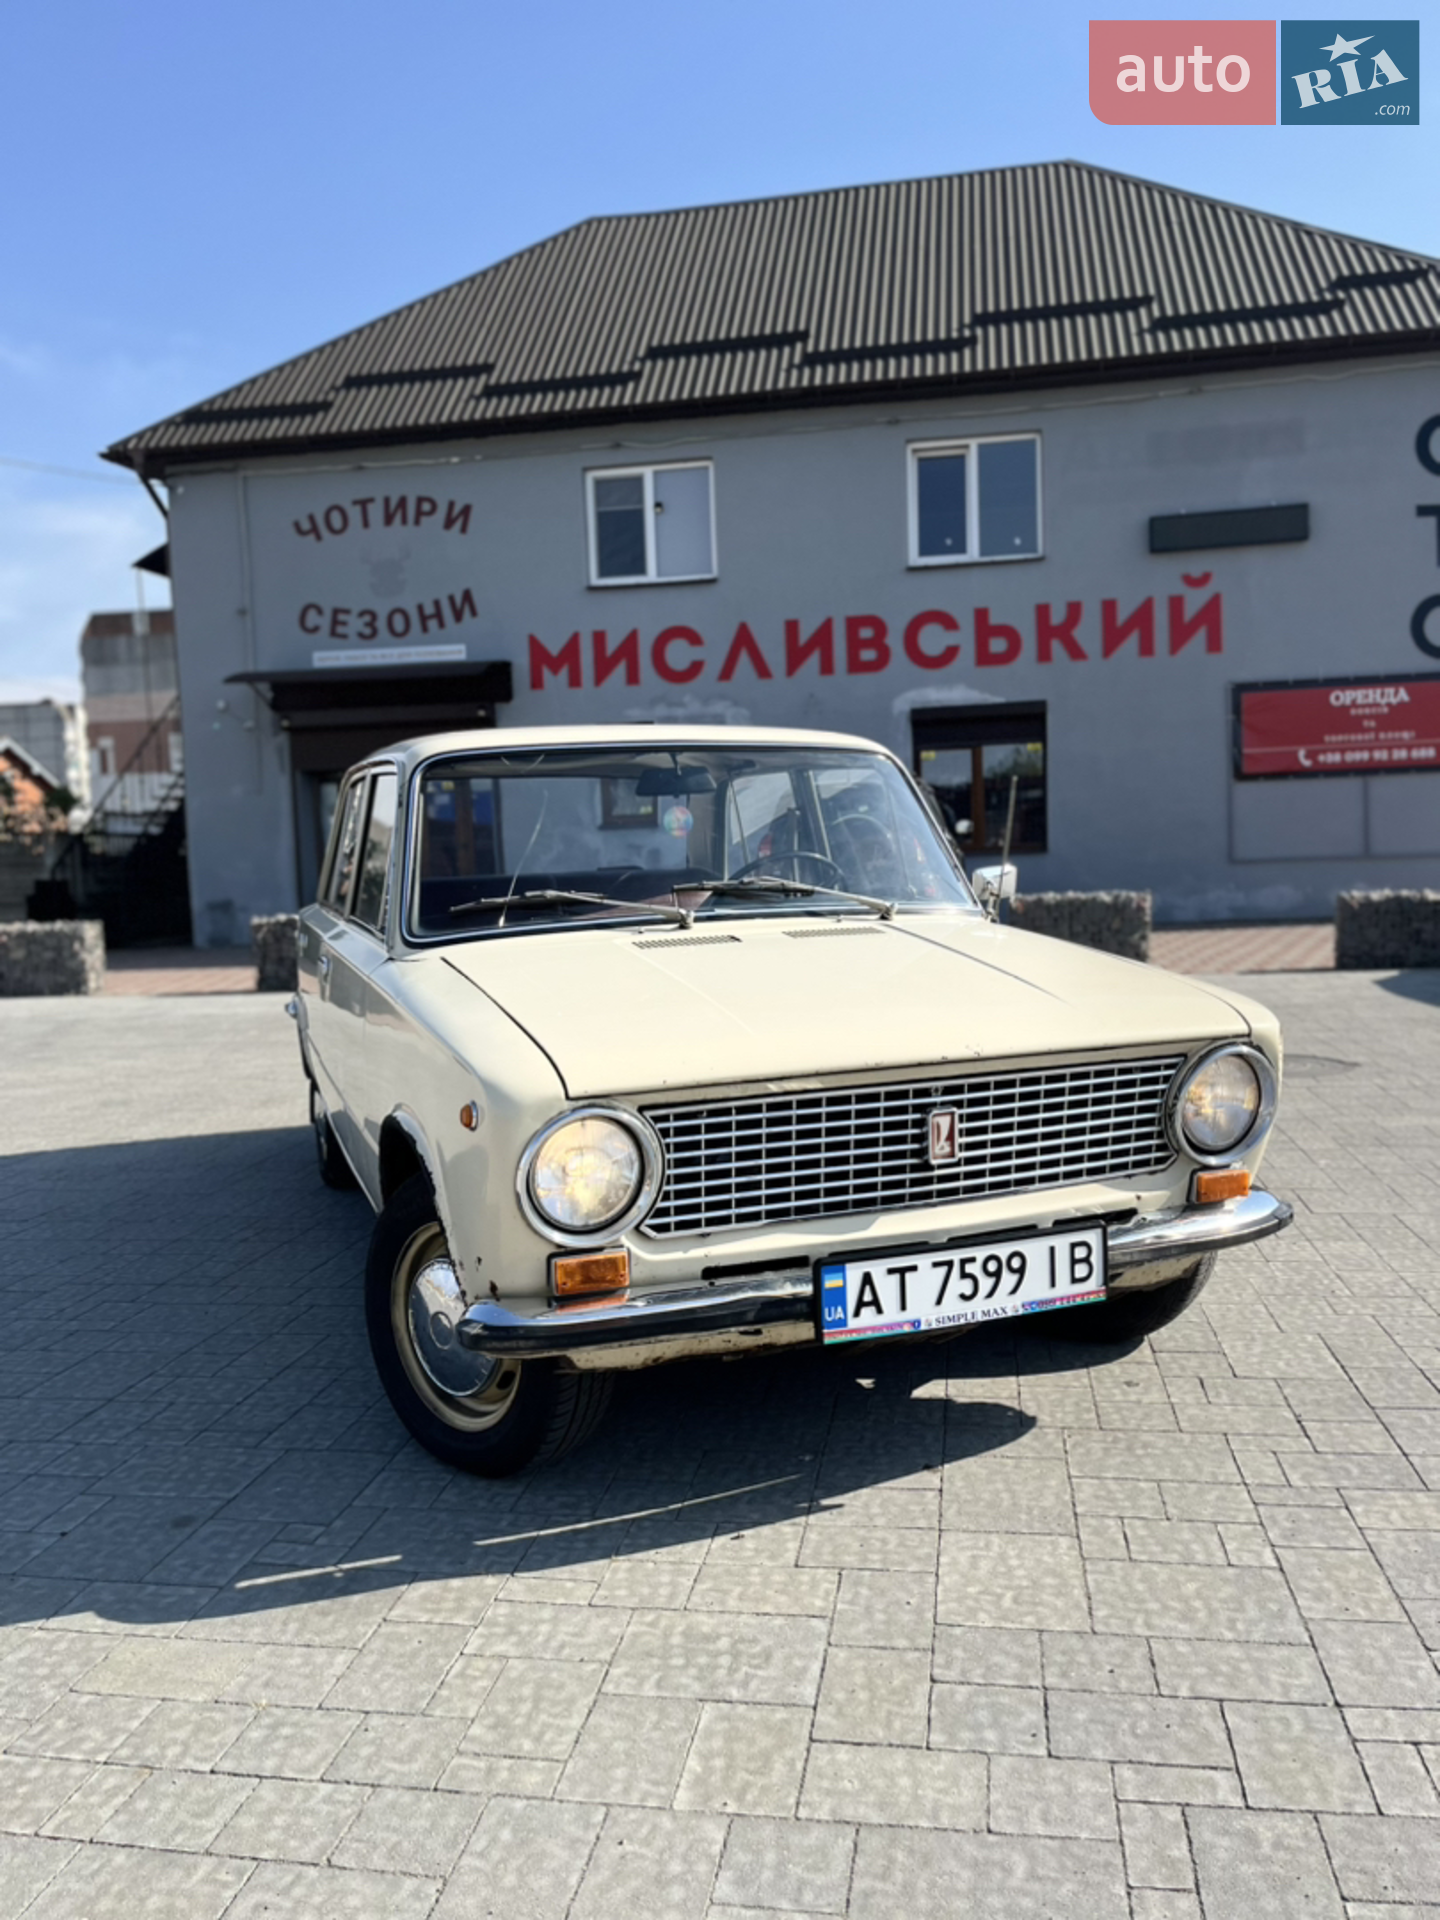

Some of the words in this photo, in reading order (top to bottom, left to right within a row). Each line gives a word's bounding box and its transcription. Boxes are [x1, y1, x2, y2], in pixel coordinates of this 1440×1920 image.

[293, 495, 473, 542] ЧОТИРИ
[299, 587, 479, 641] СЕЗОНИ
[528, 572, 1223, 690] МИСЛИВСЬКИЙ
[1329, 687, 1410, 707] ОРЕНДА
[852, 1265, 918, 1318] AT
[931, 1250, 1027, 1306] 7599
[1049, 1240, 1093, 1288] IB
[824, 1306, 845, 1322] UA
[935, 1309, 979, 1326] SIMPLE
[981, 1306, 1008, 1321] MAX
